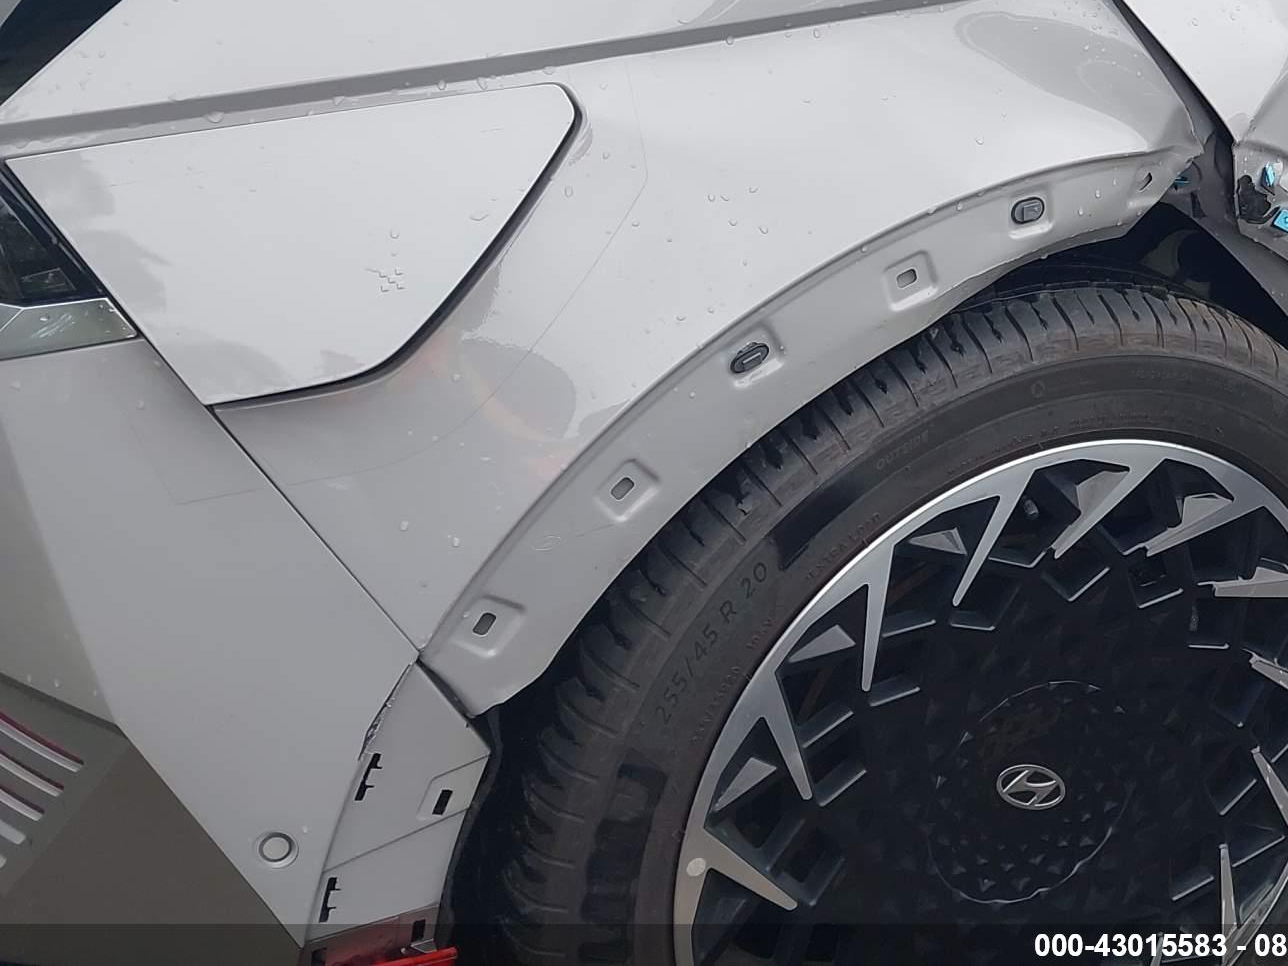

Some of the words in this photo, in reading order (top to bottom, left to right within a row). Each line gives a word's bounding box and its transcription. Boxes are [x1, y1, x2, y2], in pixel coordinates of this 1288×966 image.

[655, 622, 720, 724] 255/45
[719, 600, 738, 624] R
[740, 561, 768, 599] 20
